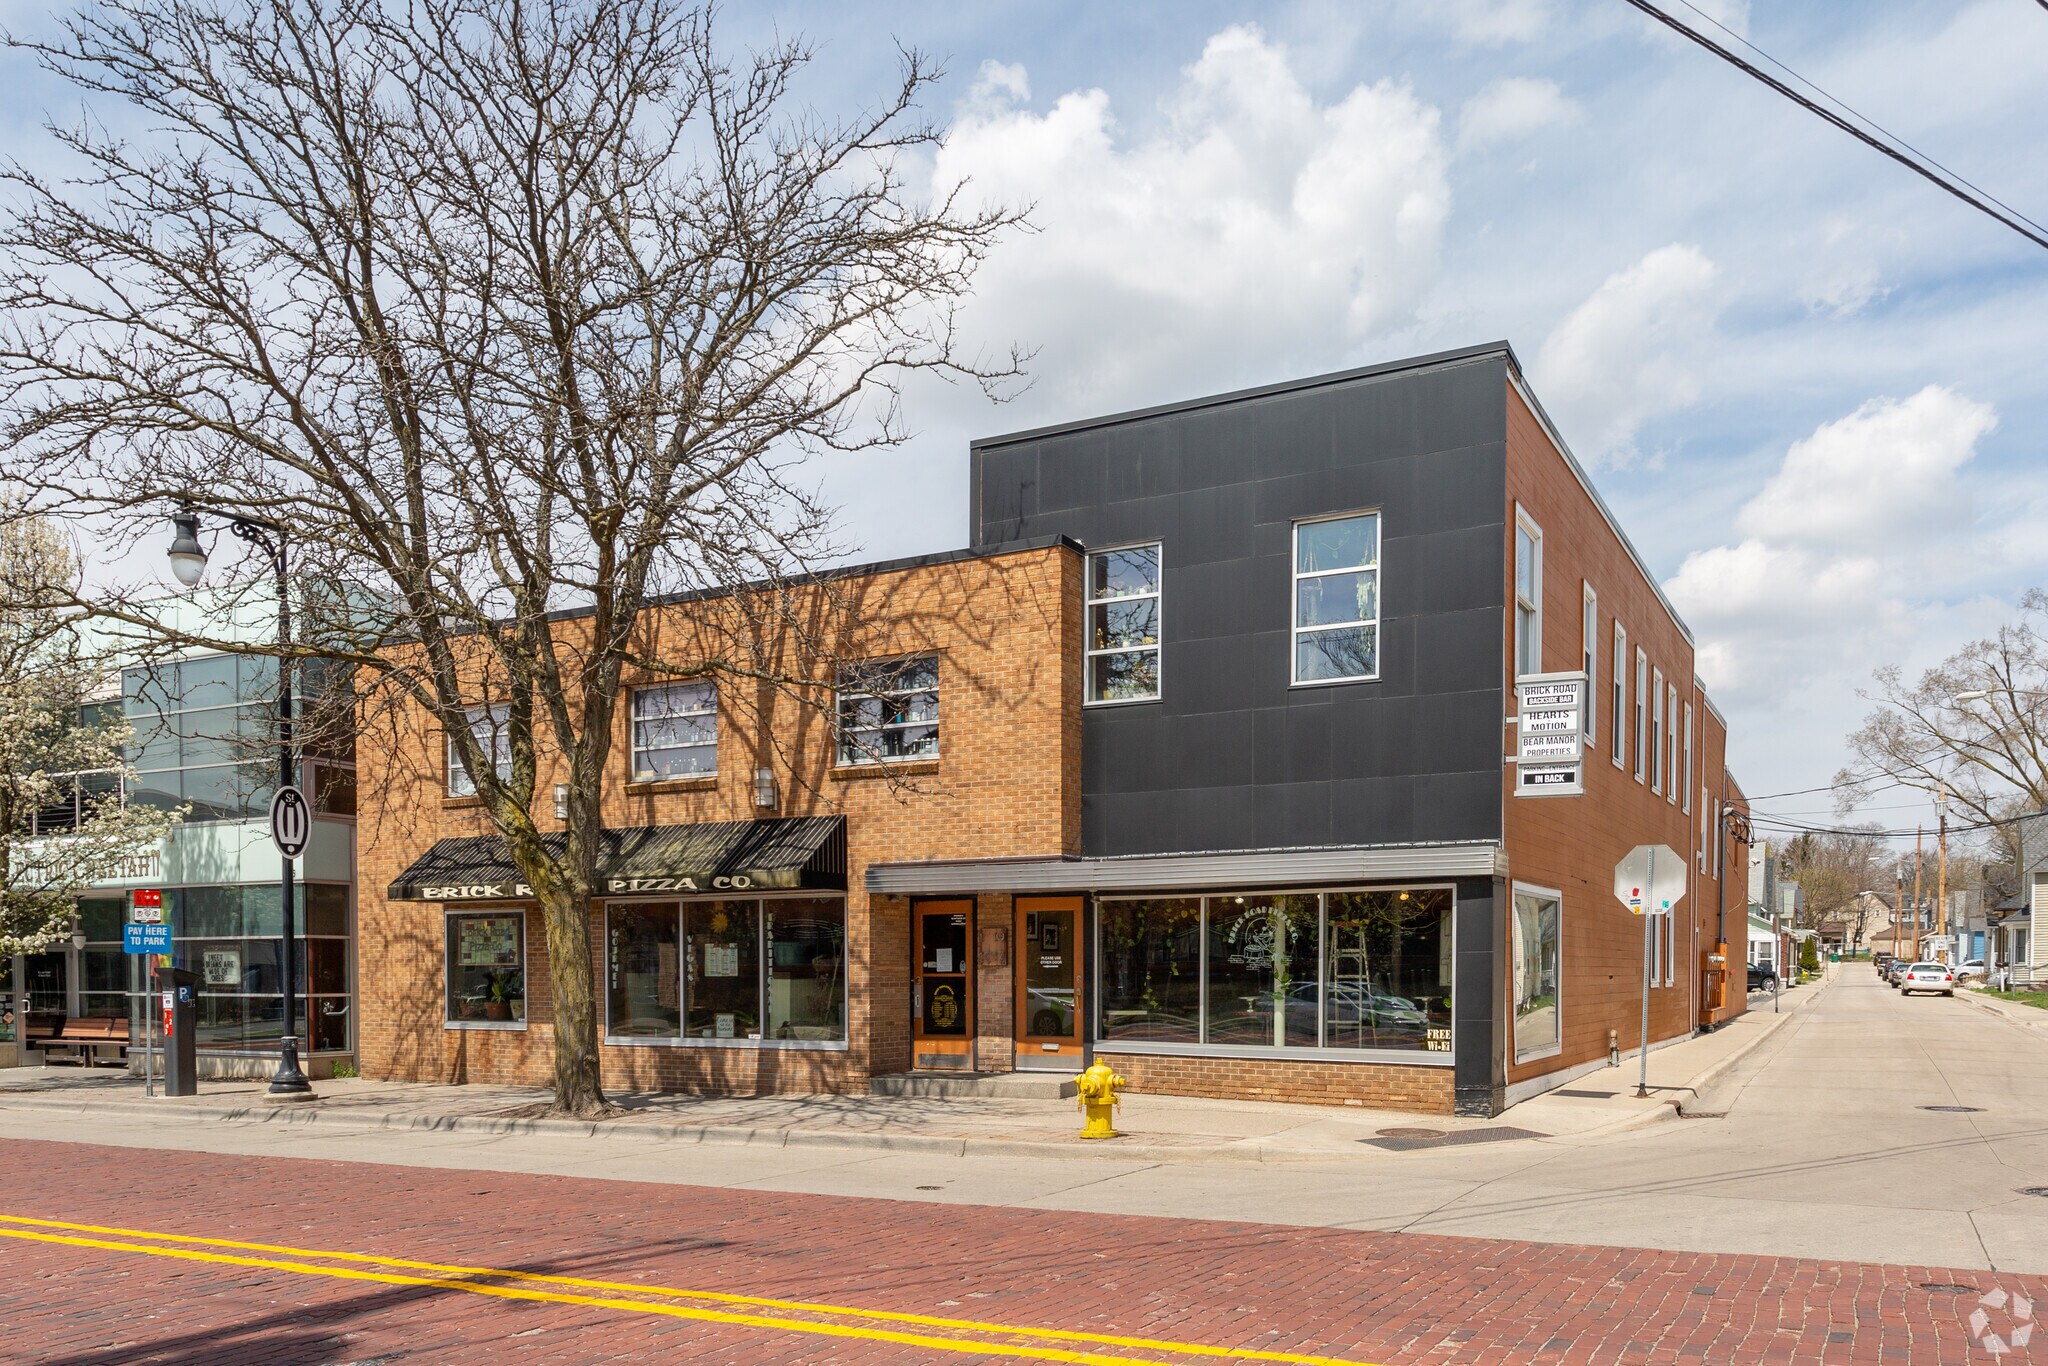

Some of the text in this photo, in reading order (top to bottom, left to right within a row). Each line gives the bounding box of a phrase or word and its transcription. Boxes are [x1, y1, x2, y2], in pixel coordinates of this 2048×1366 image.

[1524, 684, 1577, 696] BRICK ROAD
[1529, 710, 1569, 720] HEARTS
[1531, 722, 1567, 731] MOTION
[1523, 735, 1575, 746] BEAR MANOR
[1527, 748, 1571, 756] PROPERTIES
[1535, 774, 1565, 783] IN BACK
[608, 877, 698, 892] PIZZA
[421, 884, 504, 898] BRICK
[128, 927, 168, 936] PAY HERE
[130, 936, 166, 946] TO PARK
[686, 934, 694, 982] VEGAN
[179, 987, 187, 999] P
[1427, 1029, 1451, 1039] FREE
